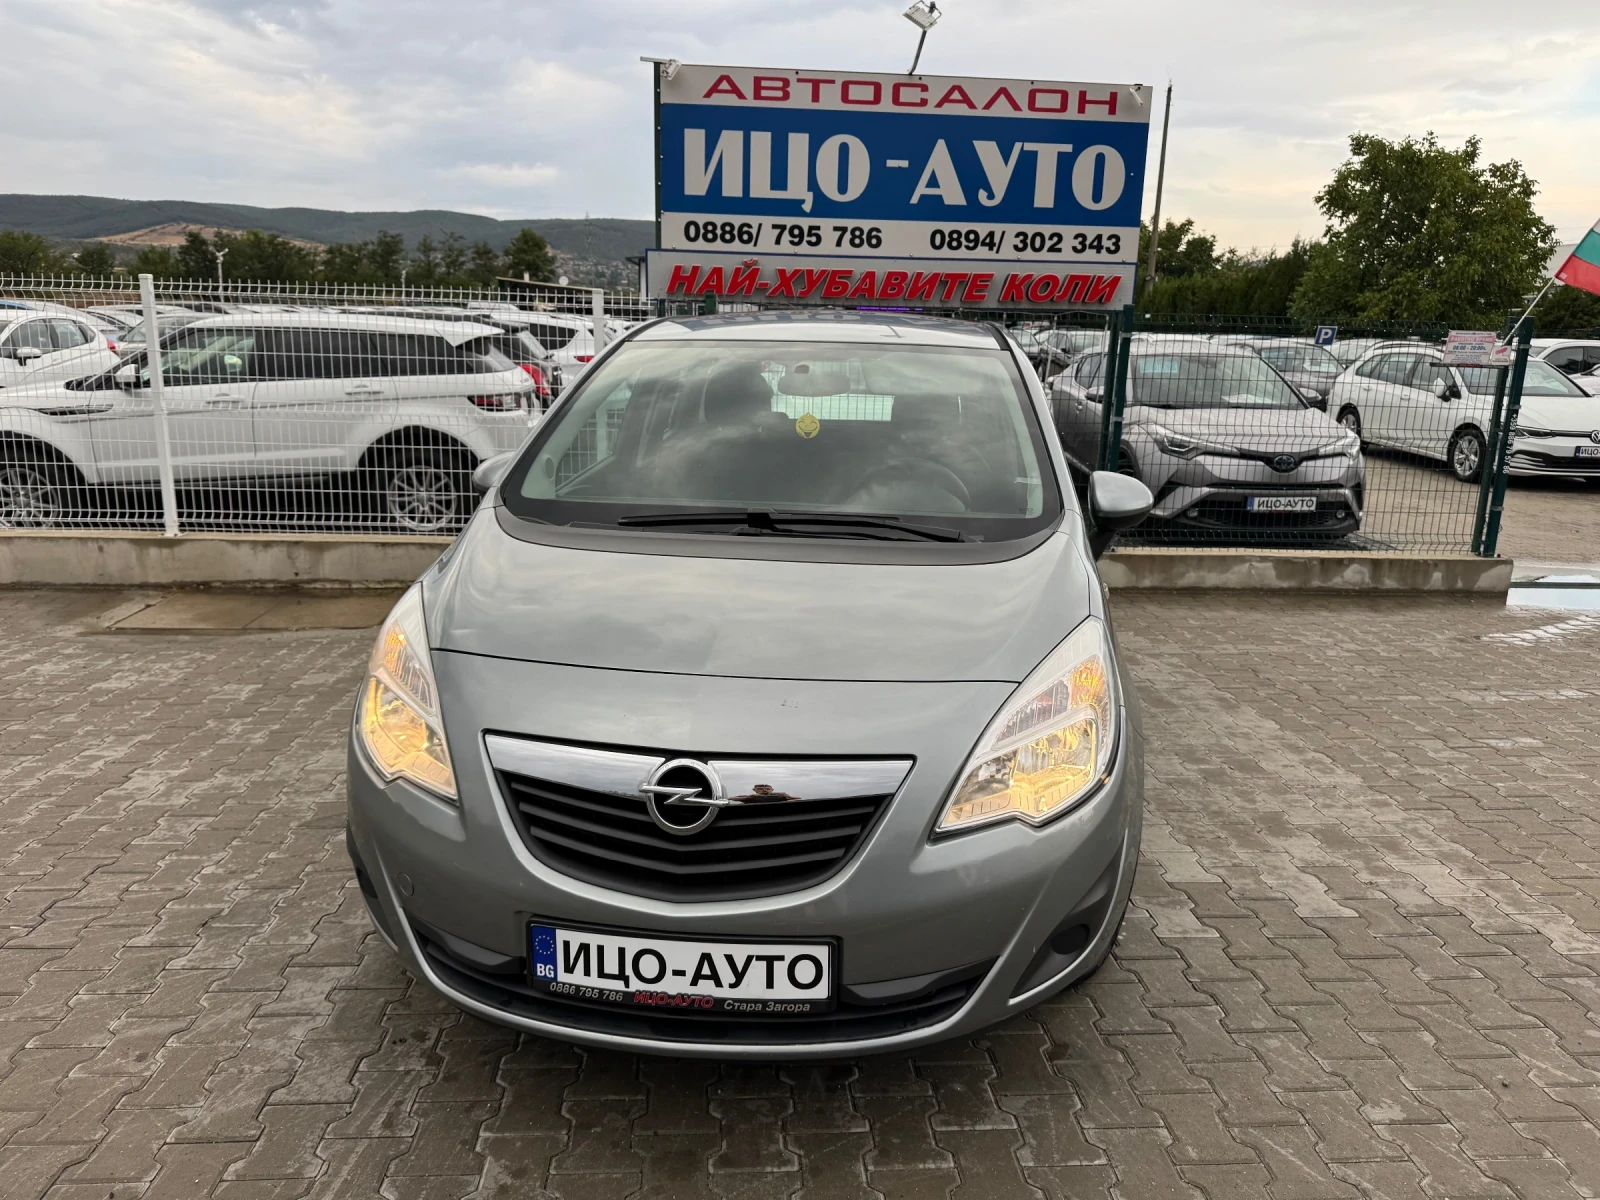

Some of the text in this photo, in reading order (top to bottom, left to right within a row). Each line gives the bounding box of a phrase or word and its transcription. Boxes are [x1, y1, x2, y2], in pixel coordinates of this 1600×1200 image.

[702, 74, 1118, 115] АВТОСАЛОН
[683, 220, 883, 249] 0886/ 795 786
[929, 229, 1121, 255] 0894/ 302 343
[665, 258, 1123, 304] НАЙ-ХУБАВИТЕ КОЛИ
[1507, 431, 1516, 445] 886
[1502, 465, 1510, 474] 86
[1257, 499, 1314, 509] ИЦО-АУТО
[536, 962, 555, 979] BG
[562, 940, 824, 990] ИЦО-АУТО
[550, 982, 811, 1013] 0886 795 786 ИЦО-АУТО Стара Загора
